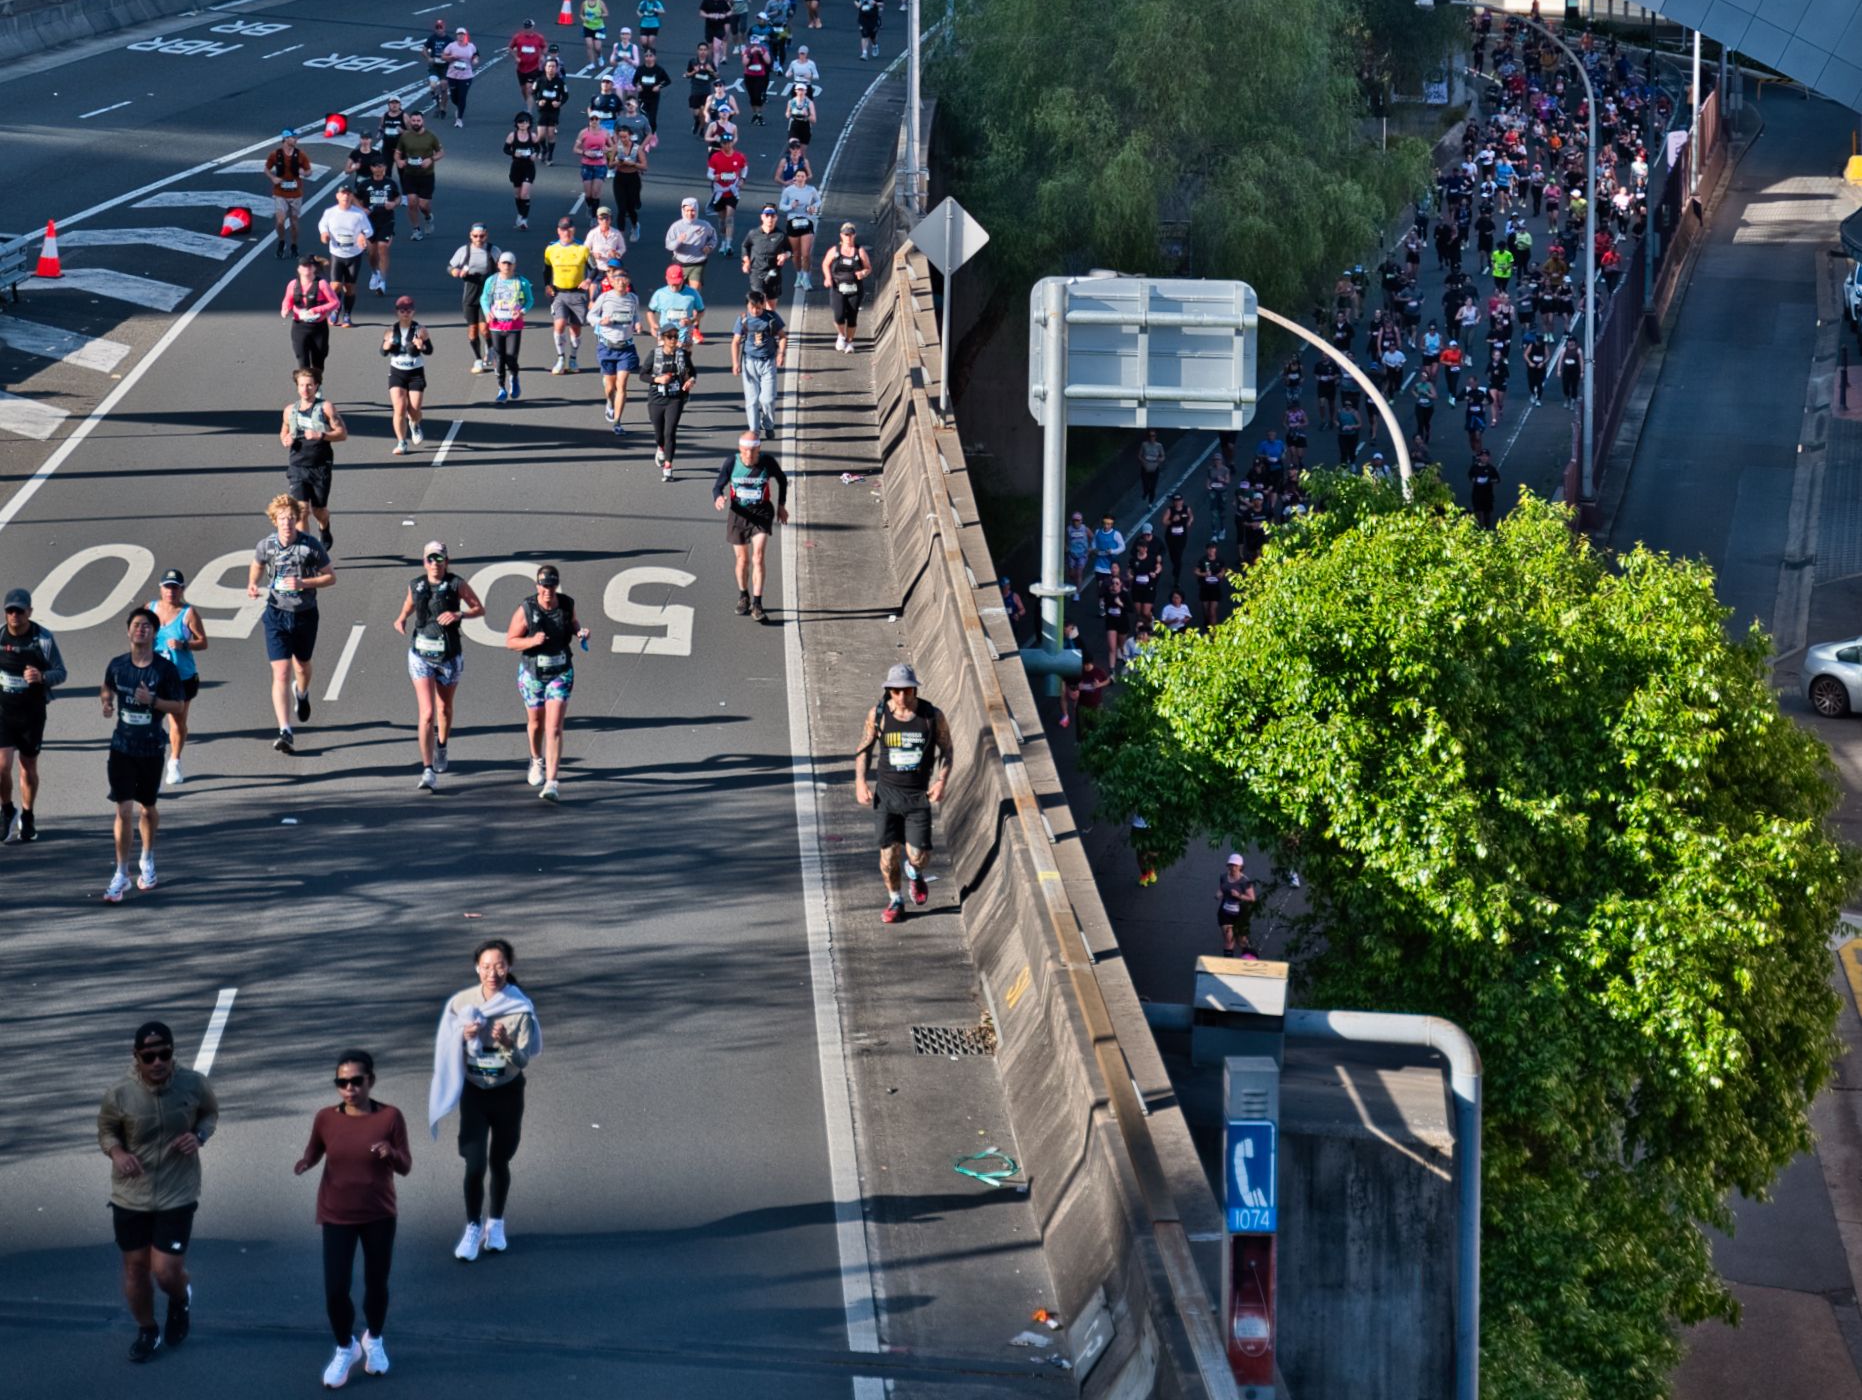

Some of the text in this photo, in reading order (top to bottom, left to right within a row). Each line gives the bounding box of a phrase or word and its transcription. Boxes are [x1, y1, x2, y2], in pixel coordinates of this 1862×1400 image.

[209, 20, 292, 36] BR
[126, 37, 244, 57] HBR
[302, 53, 419, 74] HBR
[31, 543, 270, 640] 50
[1235, 1209, 1270, 1230] 1074
